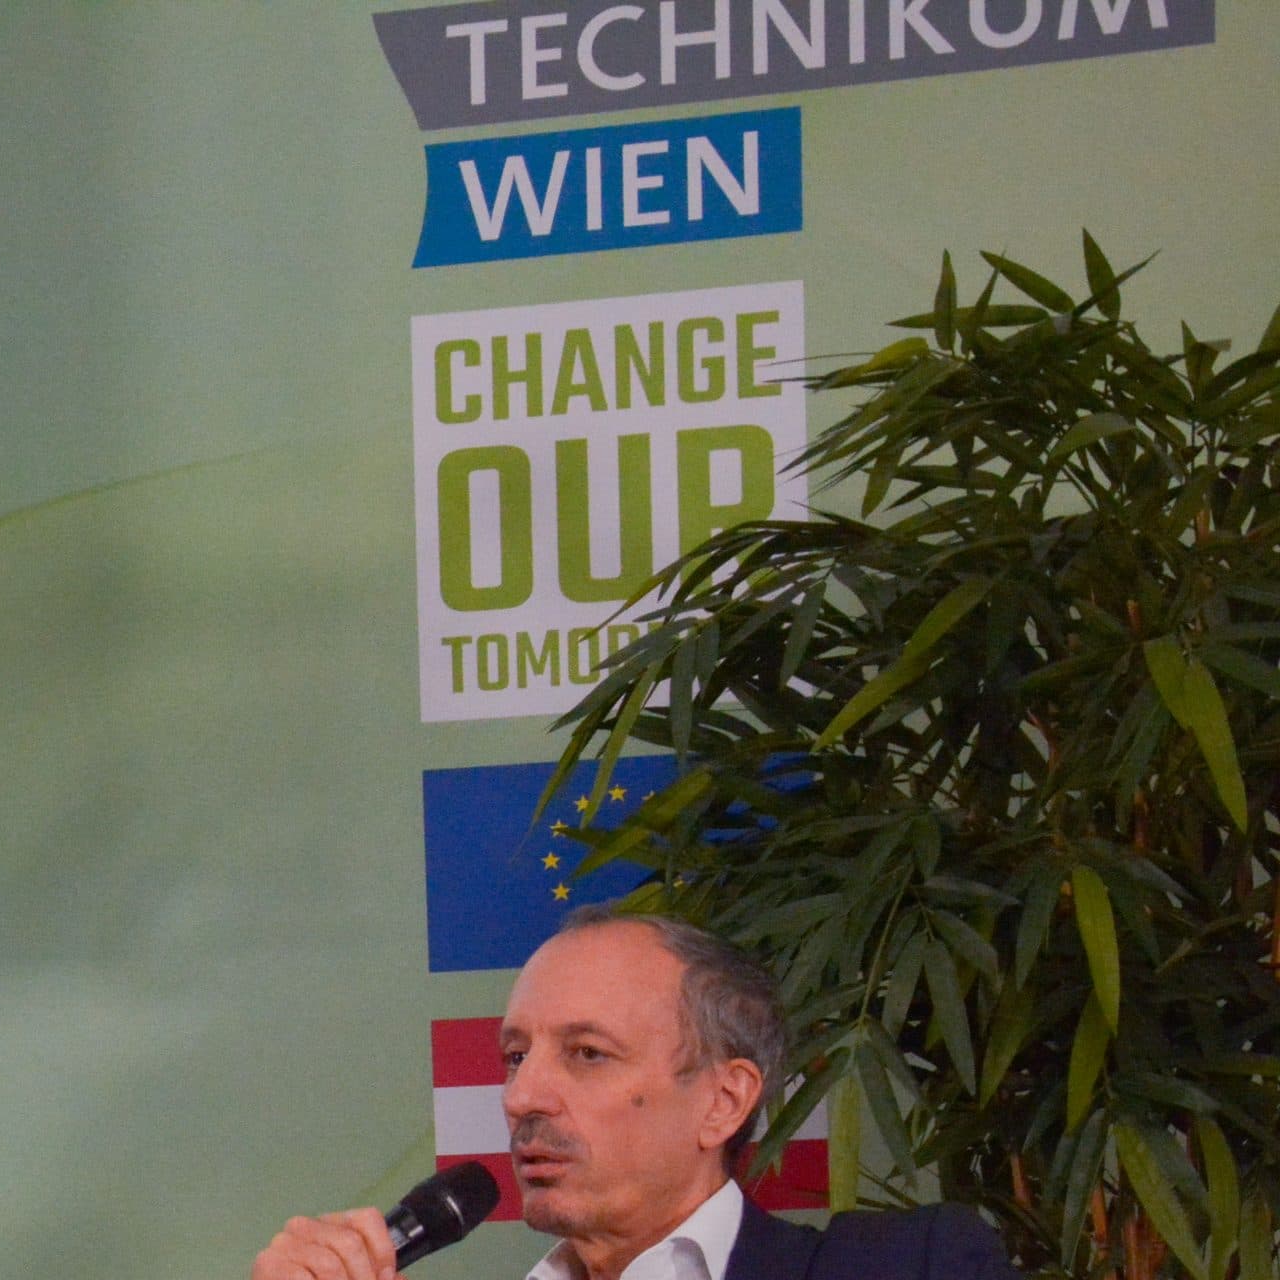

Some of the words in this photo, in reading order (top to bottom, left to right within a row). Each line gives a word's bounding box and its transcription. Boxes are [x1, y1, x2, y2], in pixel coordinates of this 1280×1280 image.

[458, 130, 761, 241] WIEN
[432, 310, 783, 426] CHANGE
[437, 424, 778, 613] OUR
